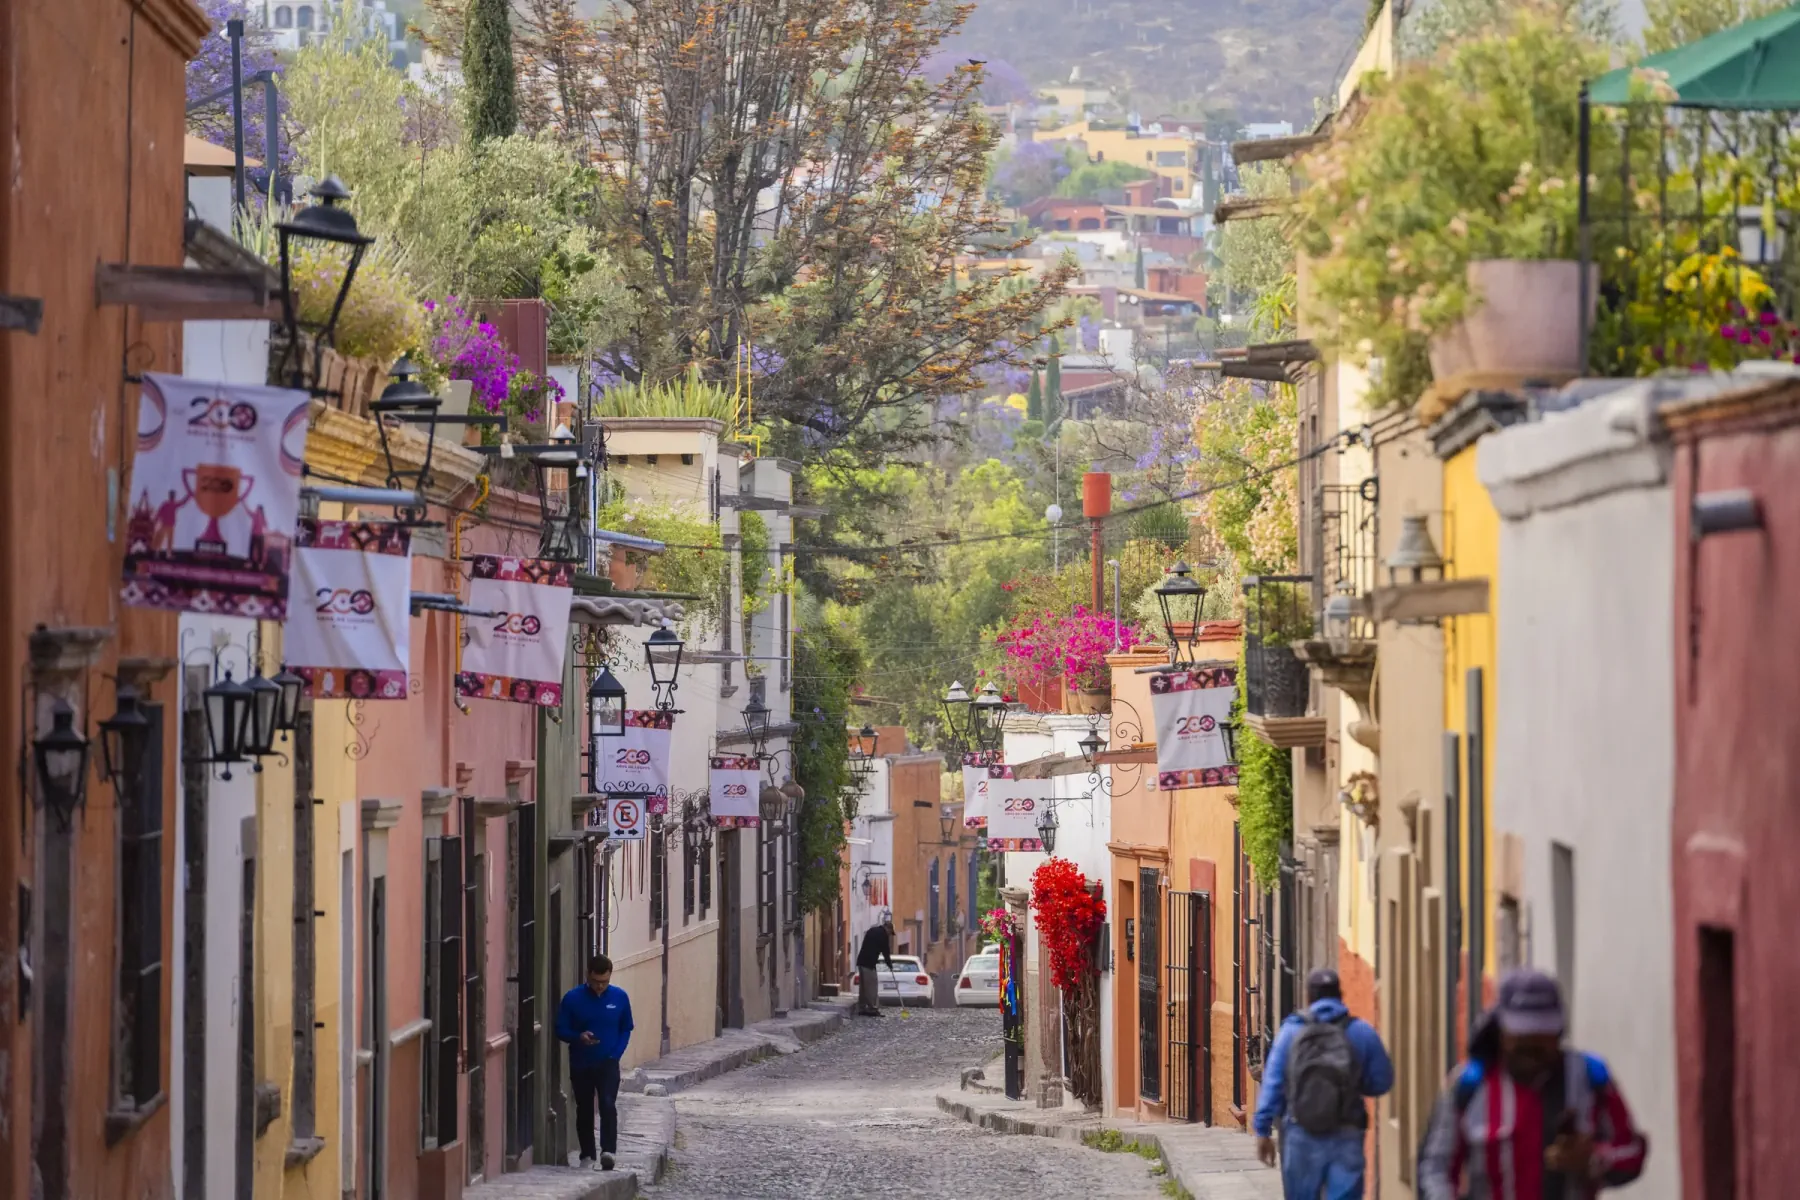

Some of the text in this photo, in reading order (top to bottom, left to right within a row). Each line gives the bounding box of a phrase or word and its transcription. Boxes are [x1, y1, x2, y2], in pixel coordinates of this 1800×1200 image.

[316, 588, 374, 615] 200
[494, 611, 541, 635] 200
[1176, 714, 1216, 735] 200
[616, 748, 651, 765] 200
[723, 784, 747, 795] 200
[1004, 798, 1035, 811] 200
[620, 806, 632, 822] E
